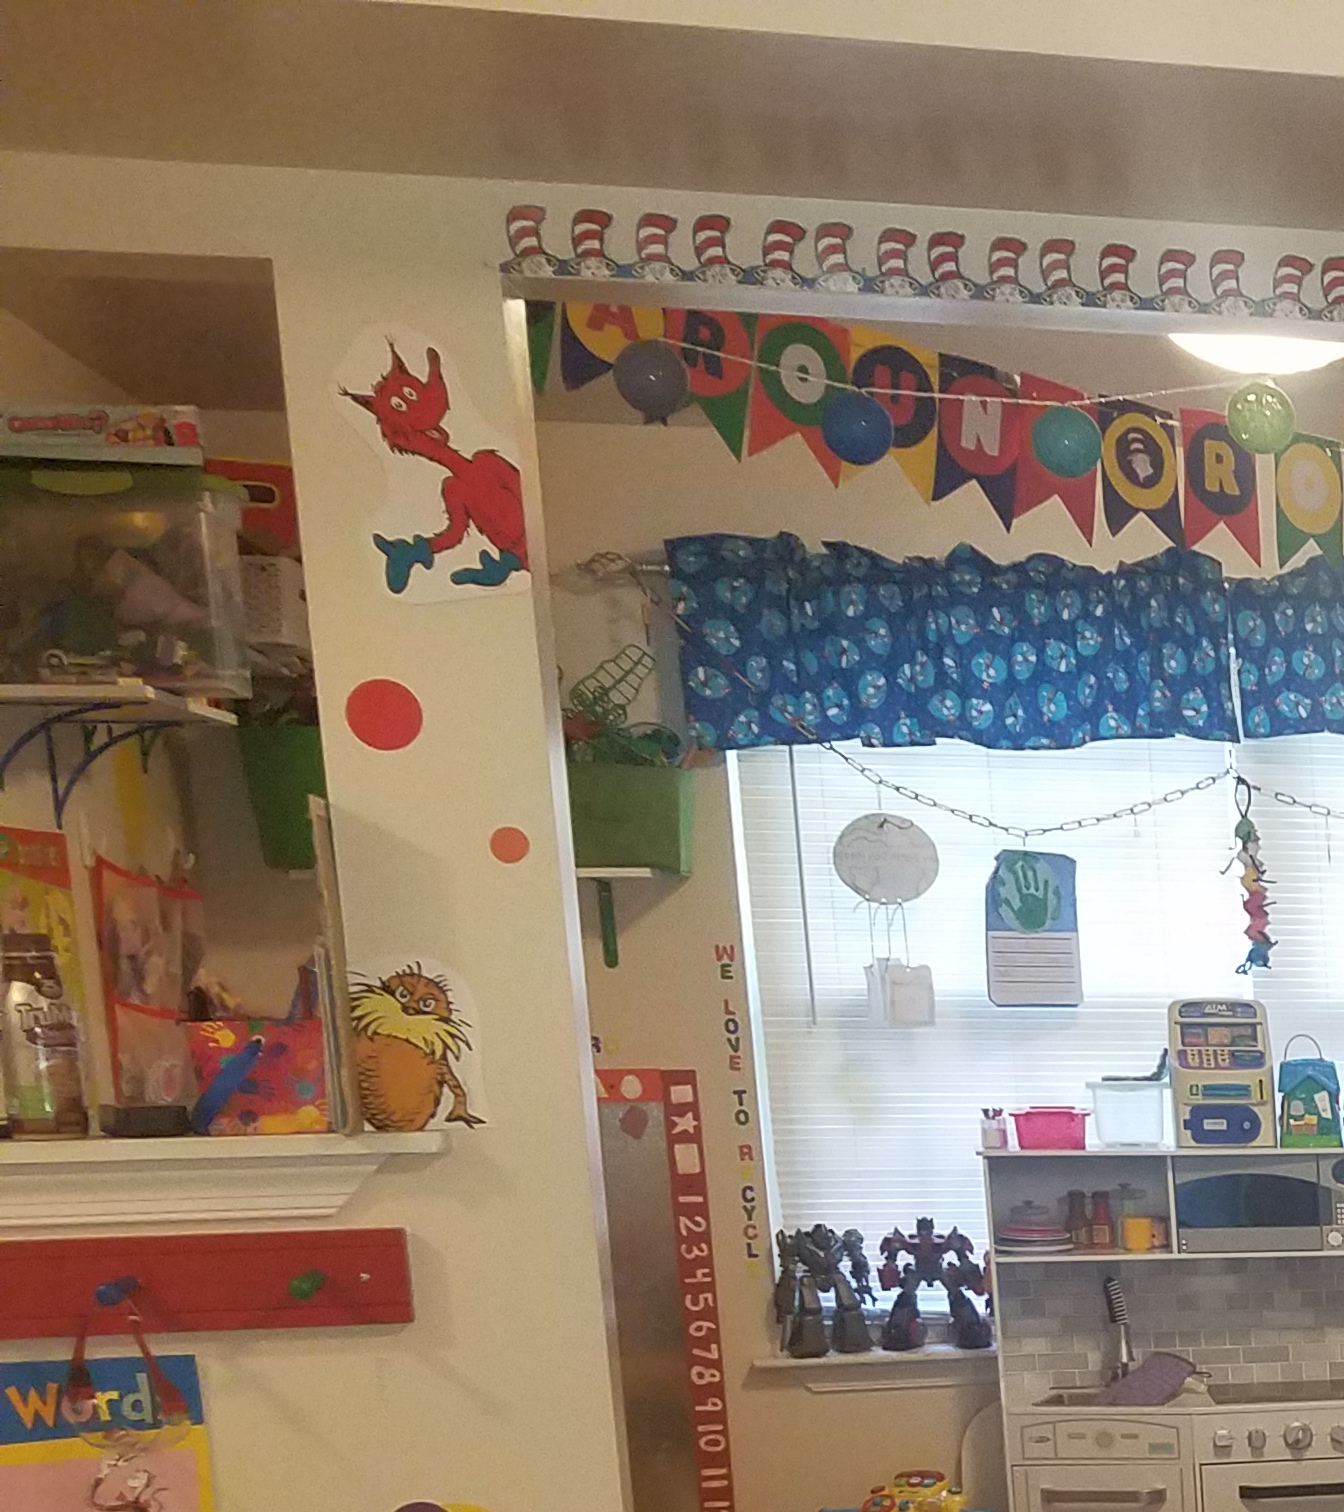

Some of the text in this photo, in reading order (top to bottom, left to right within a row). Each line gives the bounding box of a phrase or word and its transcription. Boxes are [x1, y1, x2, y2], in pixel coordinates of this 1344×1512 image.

[722, 998, 743, 1072] LOVE
[678, 1195, 704, 1203] 1
[678, 1215, 707, 1236] 2
[680, 1242, 709, 1262] 3
[683, 1268, 712, 1288] 4
[685, 1291, 715, 1312] 5
[688, 1319, 718, 1337] 6
[691, 1343, 719, 1361] 7
[691, 1364, 721, 1386] 8
[694, 1398, 722, 1413] 9
[698, 1422, 726, 1453] 10
[700, 1467, 728, 1489] 11
